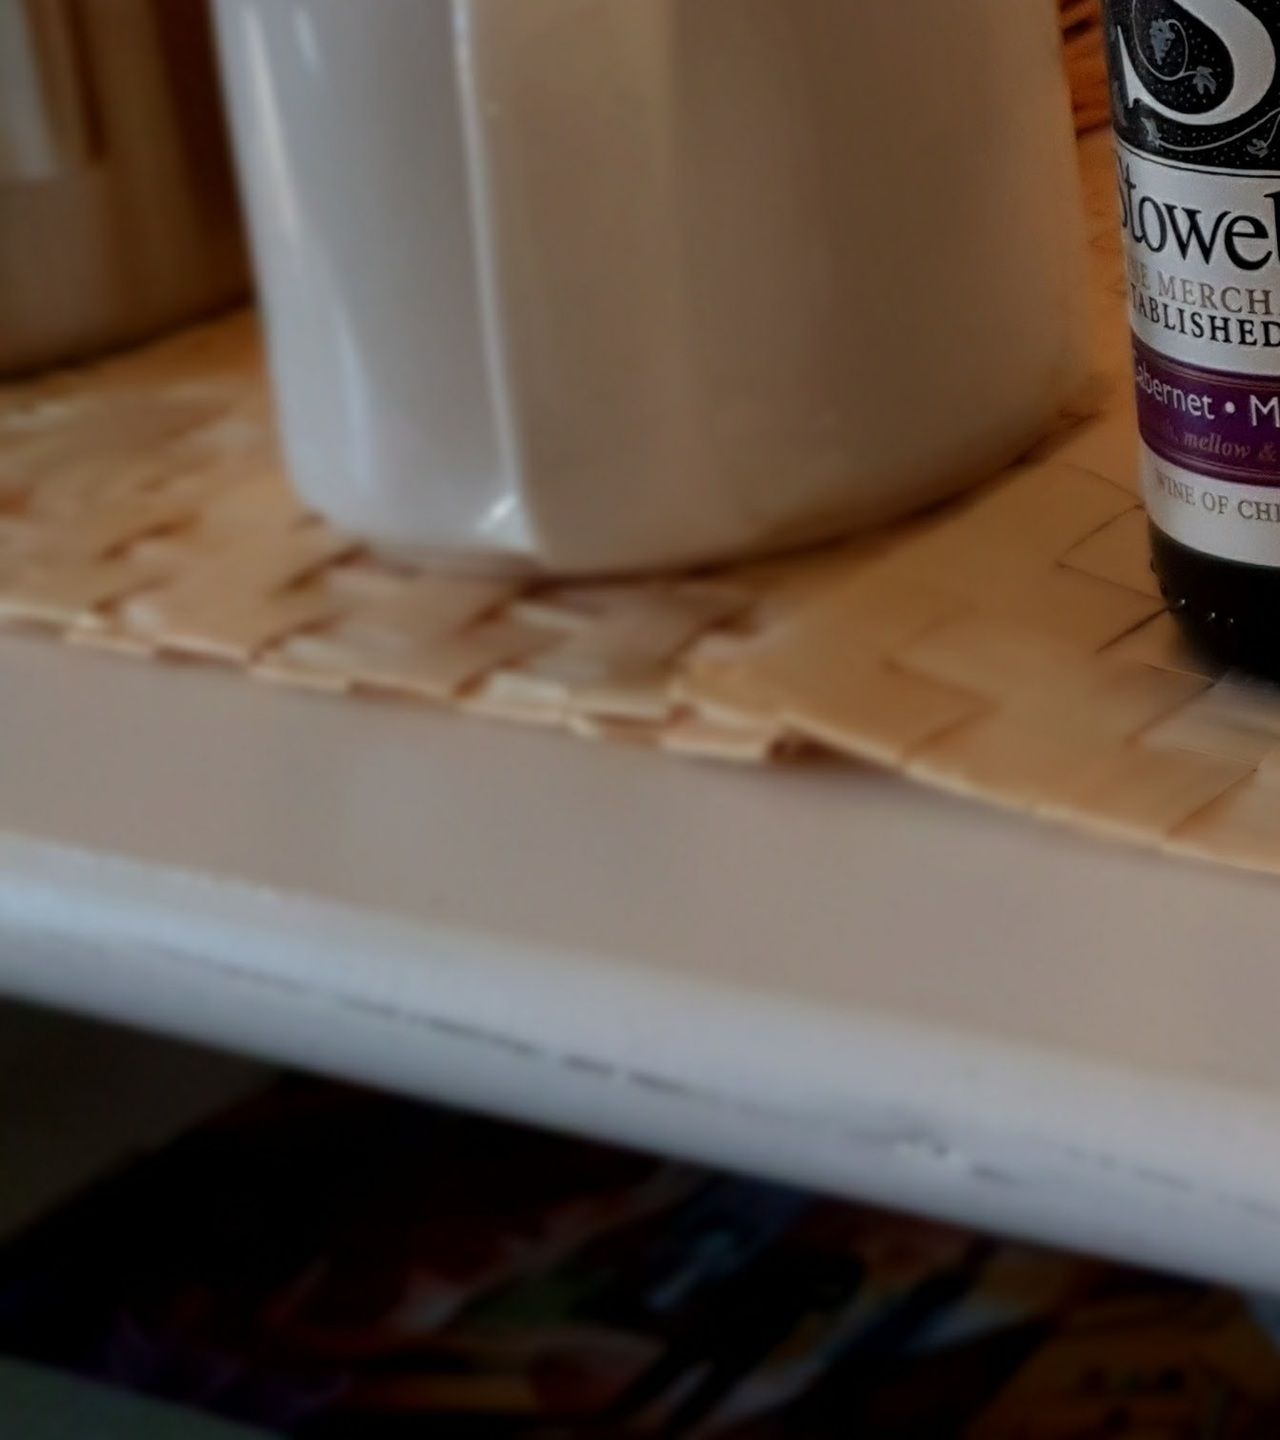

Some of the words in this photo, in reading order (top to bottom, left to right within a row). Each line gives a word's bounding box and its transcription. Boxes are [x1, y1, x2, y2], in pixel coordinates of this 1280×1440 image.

[1135, 362, 1215, 420] abernet
[1182, 431, 1250, 460] mellow
[1155, 468, 1197, 507] WINE
[1202, 491, 1229, 515] OF
